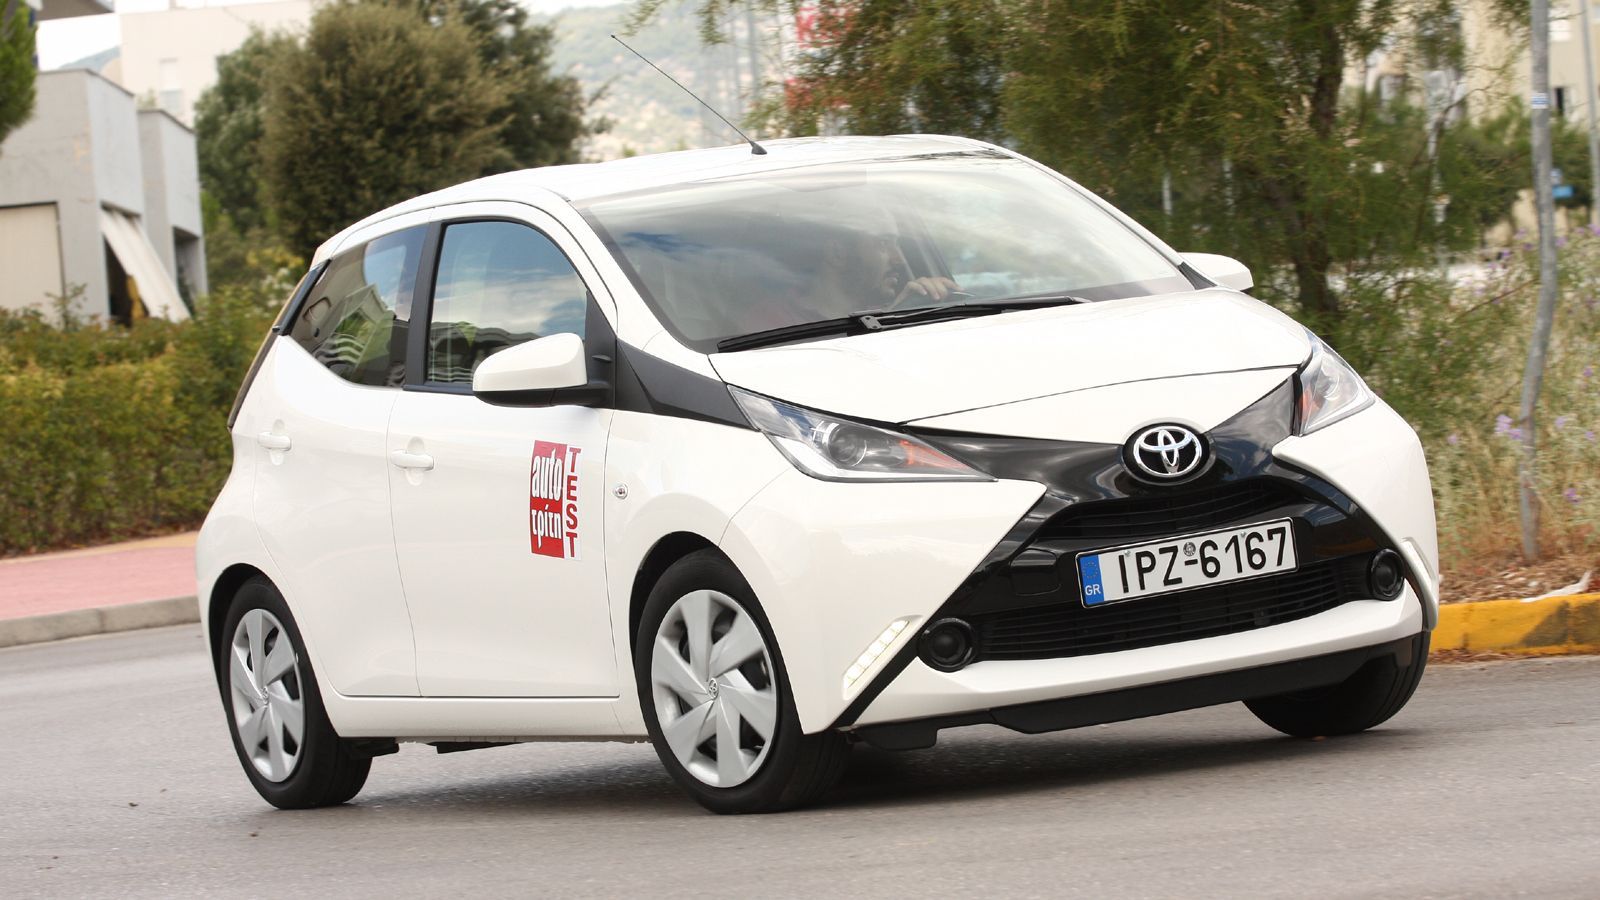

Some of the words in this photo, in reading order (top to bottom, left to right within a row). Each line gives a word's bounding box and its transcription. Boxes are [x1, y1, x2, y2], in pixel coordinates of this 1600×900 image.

[531, 448, 562, 501] auto
[565, 447, 581, 557] TEST
[1118, 526, 1286, 593] IPZ-6167
[1085, 584, 1101, 596] GR
